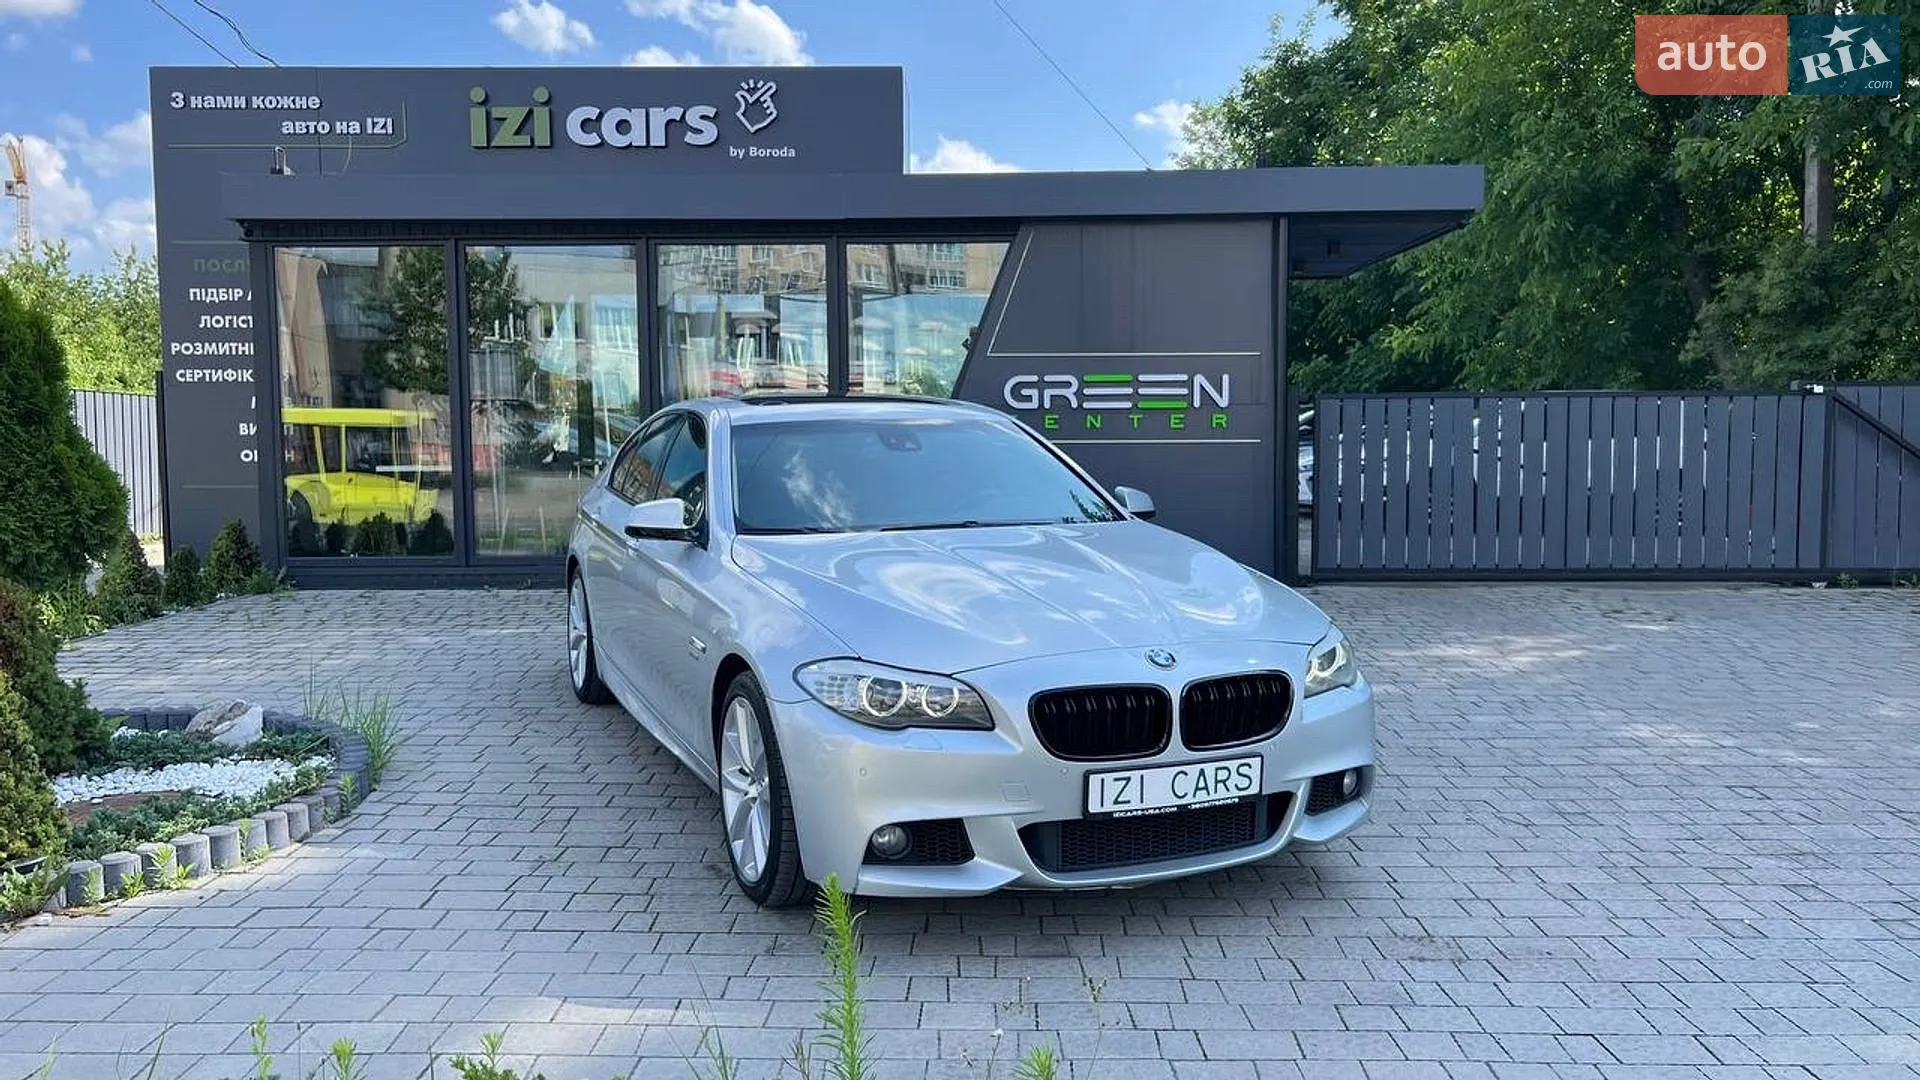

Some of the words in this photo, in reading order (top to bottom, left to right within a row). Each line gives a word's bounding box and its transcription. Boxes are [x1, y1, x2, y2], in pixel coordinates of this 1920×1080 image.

[170, 92, 185, 110] З
[190, 95, 246, 110] нами
[252, 95, 321, 110] кожне
[469, 86, 551, 148] izi
[566, 105, 719, 148] cars
[281, 119, 331, 135] авто
[336, 119, 361, 135] на
[366, 117, 393, 135] IZI
[729, 146, 744, 159] by
[749, 146, 796, 158] Boroda
[193, 258, 250, 273] ПОСЛ
[189, 288, 244, 303] ПІДБІР
[175, 369, 254, 383] СЕРТИФІК
[1003, 373, 1230, 410] GREEN
[1012, 414, 1230, 430] ENTER
[1100, 773, 1145, 808] IZI
[1171, 762, 1253, 800] CARS
